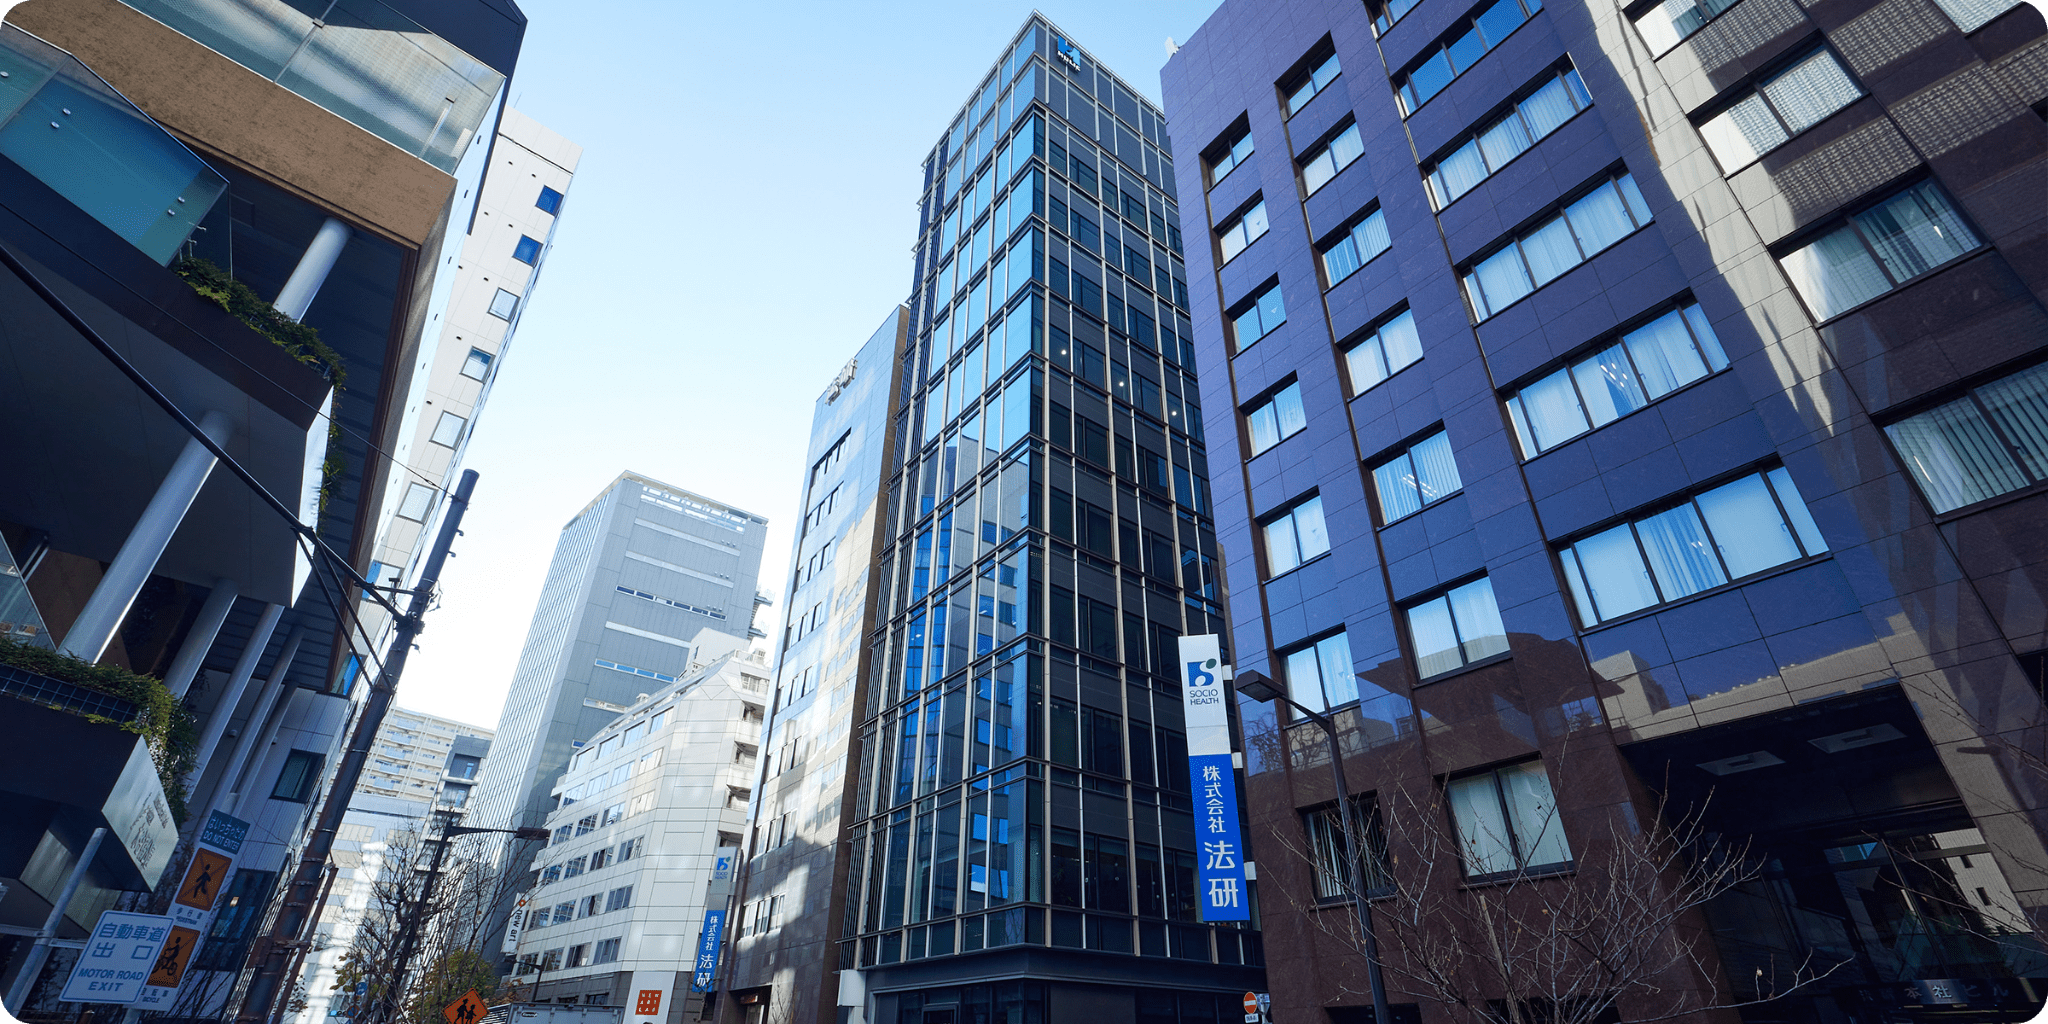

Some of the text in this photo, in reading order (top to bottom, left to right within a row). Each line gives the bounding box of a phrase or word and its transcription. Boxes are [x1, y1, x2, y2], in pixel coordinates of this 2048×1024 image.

[1189, 688, 1219, 698] SOCIO
[1190, 697, 1219, 706] HEALTH
[203, 830, 241, 851] DO NOT ENTER
[1202, 766, 1239, 908] 株式会社法研
[98, 922, 166, 943] 自動車道
[508, 909, 523, 942] new art
[92, 942, 154, 961] 出口
[78, 968, 145, 981] MOTOR ROAD
[88, 981, 124, 992] EXIT
